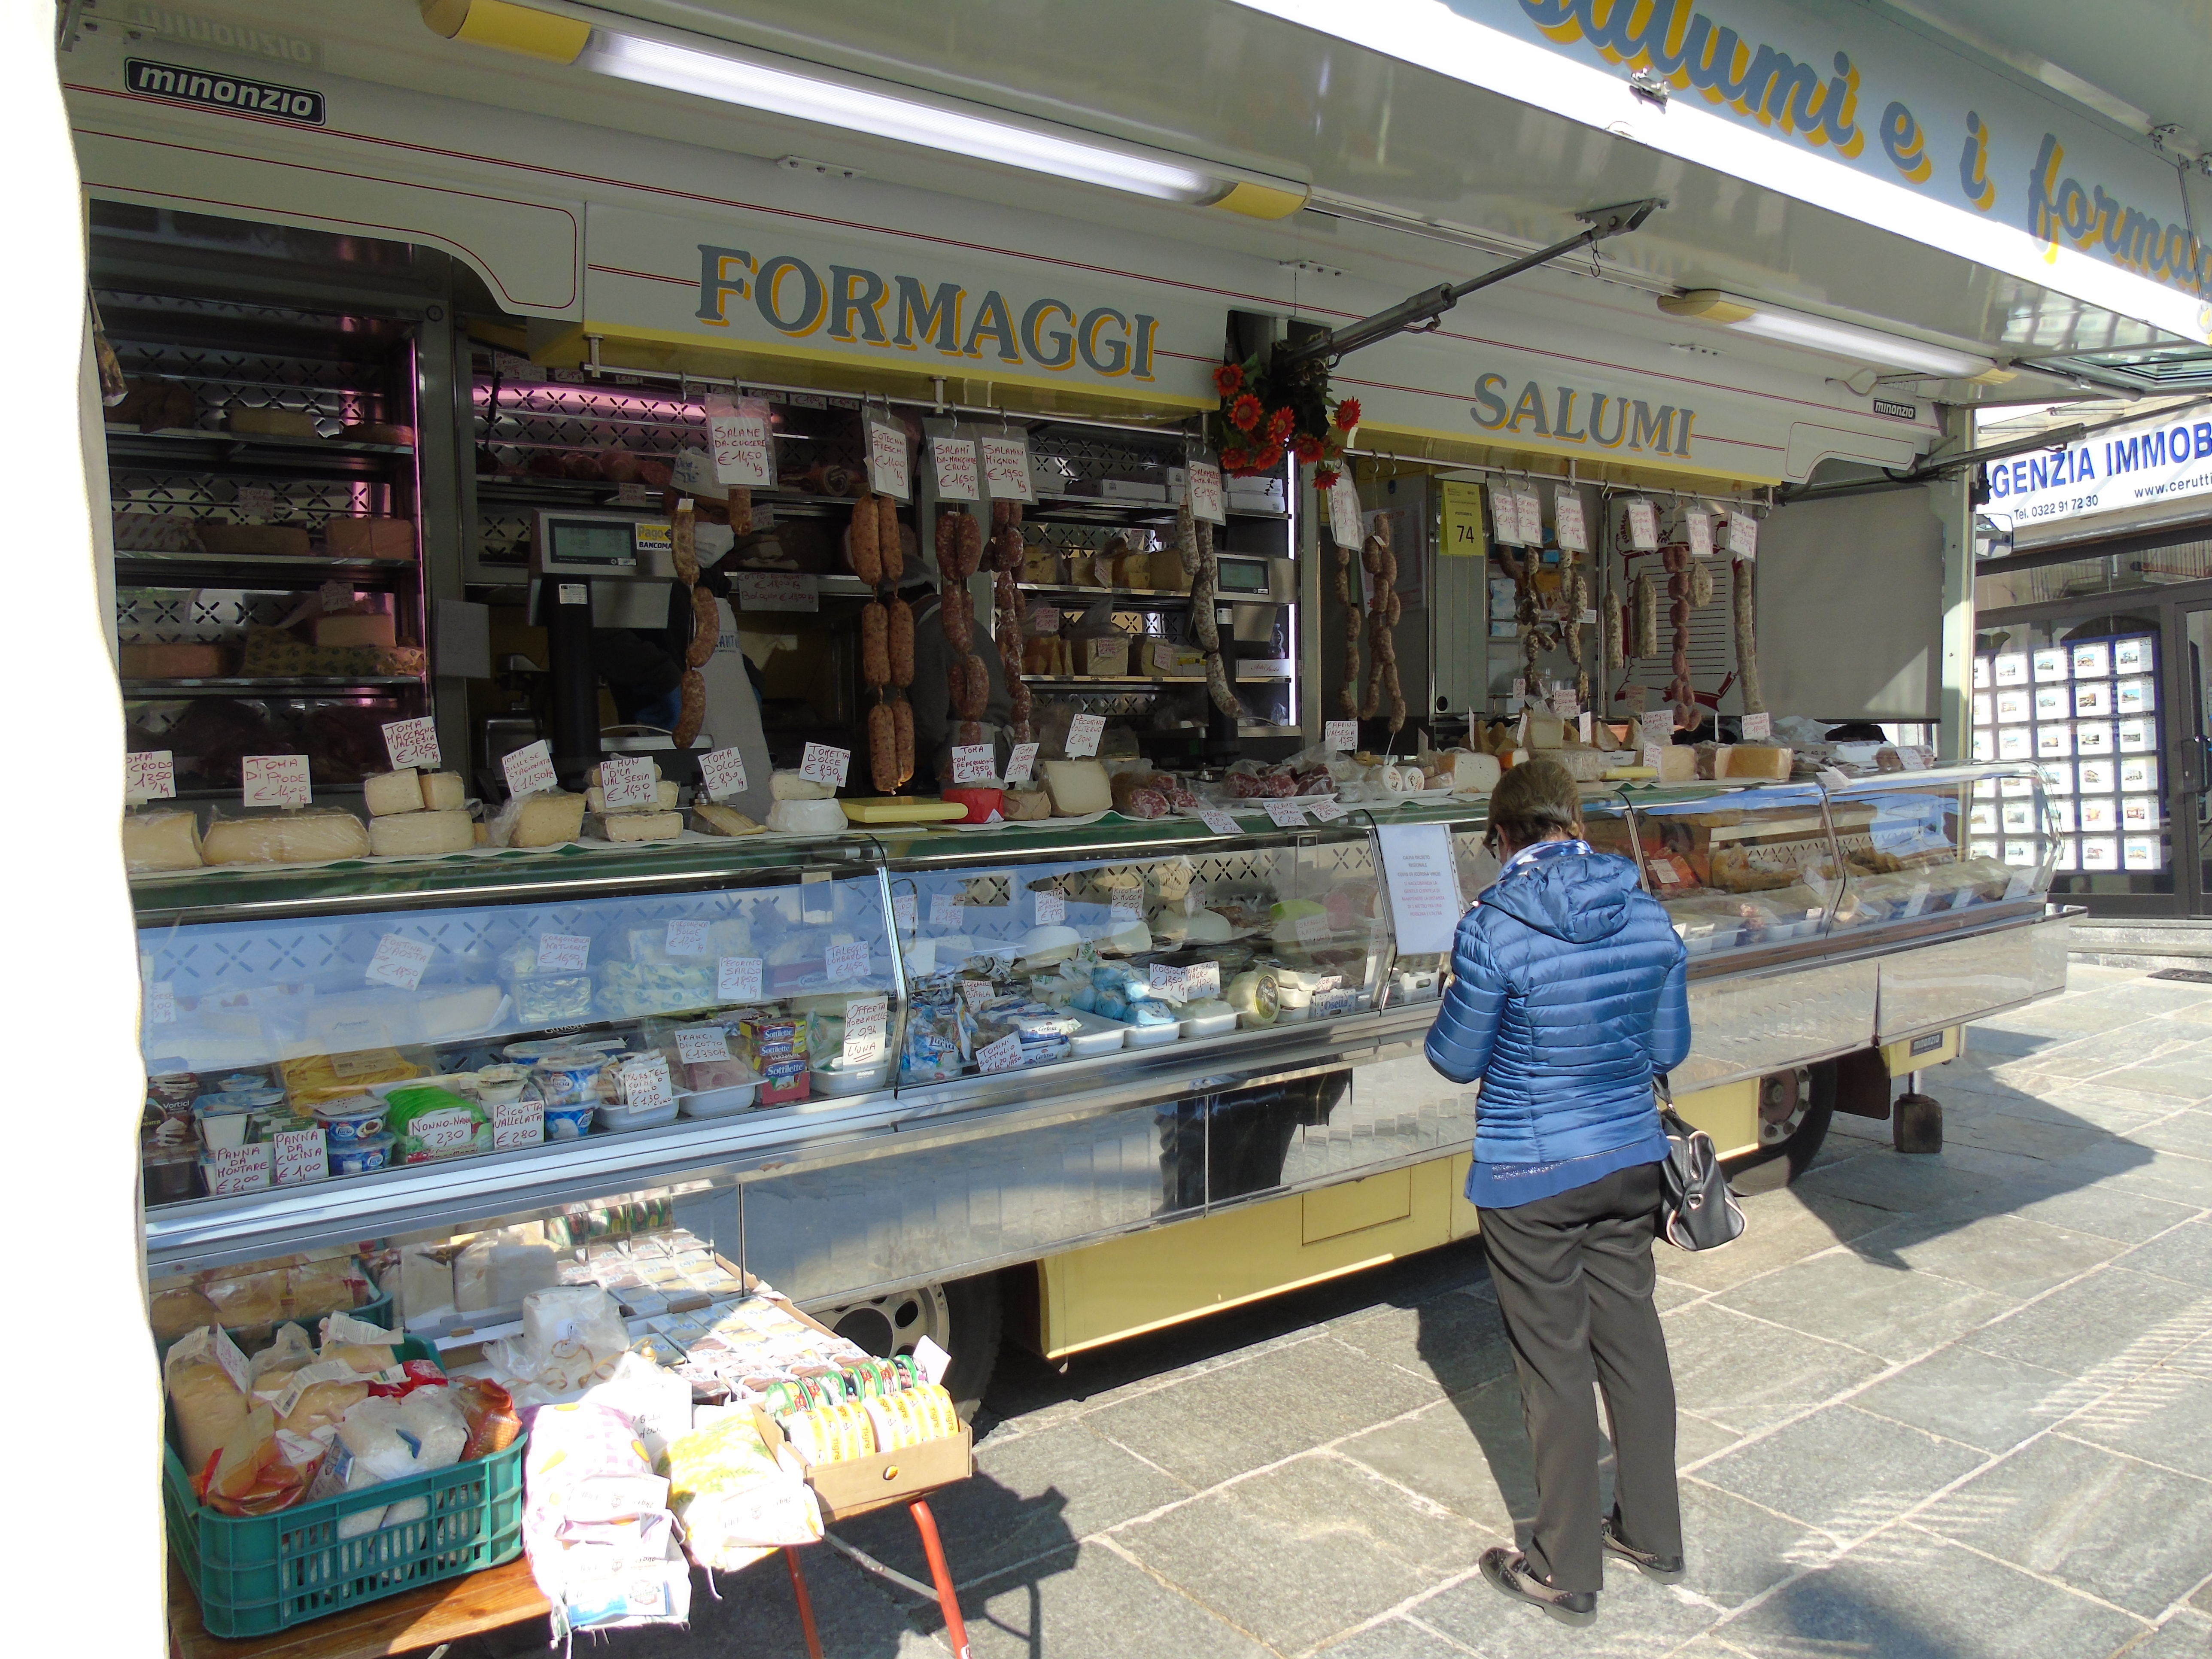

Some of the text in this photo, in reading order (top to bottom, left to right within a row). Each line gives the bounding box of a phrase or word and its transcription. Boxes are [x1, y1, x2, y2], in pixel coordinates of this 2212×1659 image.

[139, 67, 314, 117] minonzio
[1518, 0, 1863, 160] alumi
[1880, 101, 1933, 184] e
[1960, 110, 1995, 212] i
[694, 243, 1160, 383] FORMAGGI
[1470, 373, 1696, 459] SALUMI
[1875, 401, 1914, 419] minonzio
[715, 426, 761, 439] SALAME
[1990, 422, 2212, 499] GENZIA IMMOB
[952, 474, 975, 488] 16,50
[1001, 468, 1024, 482] 19,50
[2014, 495, 2098, 520] Tel. 0322 91 72 30
[638, 527, 664, 544] Pago
[1456, 525, 1474, 543] 74
[639, 542, 672, 550] BANCOMA
[1074, 714, 1104, 726] PECORINO
[384, 720, 422, 735] TOMA
[702, 749, 733, 764] TOMA
[809, 745, 850, 760] TOMETTA
[960, 746, 984, 754] TOMA
[1015, 745, 1034, 756] TOMA
[131, 761, 173, 772] CRODO
[246, 757, 297, 770] TOMA
[704, 757, 743, 776] DOLCE
[808, 754, 842, 766] DOLCE
[953, 755, 966, 764] CON
[603, 762, 614, 772] AL
[134, 772, 172, 791] 13,50
[604, 777, 620, 786] VAL
[1267, 802, 1296, 811] SALAME
[378, 944, 426, 962] D'AOSTA
[725, 966, 761, 975] SARDO
[1162, 975, 1182, 991] 13,50
[847, 1002, 886, 1019] OFFERTA
[1324, 1000, 1348, 1011] Osella
[847, 1012, 889, 1028] MOZZARELLE
[544, 1022, 588, 1034] GUYADER
[765, 1028, 793, 1038] Sottilette
[858, 1025, 876, 1040] 0,94
[761, 1044, 790, 1054] Sottilette
[848, 1042, 876, 1057] L'UNA
[929, 1036, 955, 1050] Lucia
[1036, 1052, 1054, 1060] Certosa
[626, 1067, 668, 1082] WURSTEL
[767, 1064, 804, 1076] Sottilette
[632, 1085, 657, 1096] POLLO
[163, 1100, 190, 1109] Vortici
[641, 1094, 660, 1106] 1,30
[277, 1130, 319, 1148] PANNA
[437, 1130, 464, 1147] 2,30
[513, 1129, 538, 1145] 2,80
[218, 1147, 260, 1161] PANNA
[287, 1144, 303, 1153] DA
[231, 1158, 246, 1167] DA
[276, 1147, 322, 1165] CUCINA
[218, 1161, 269, 1178] MONTARE
